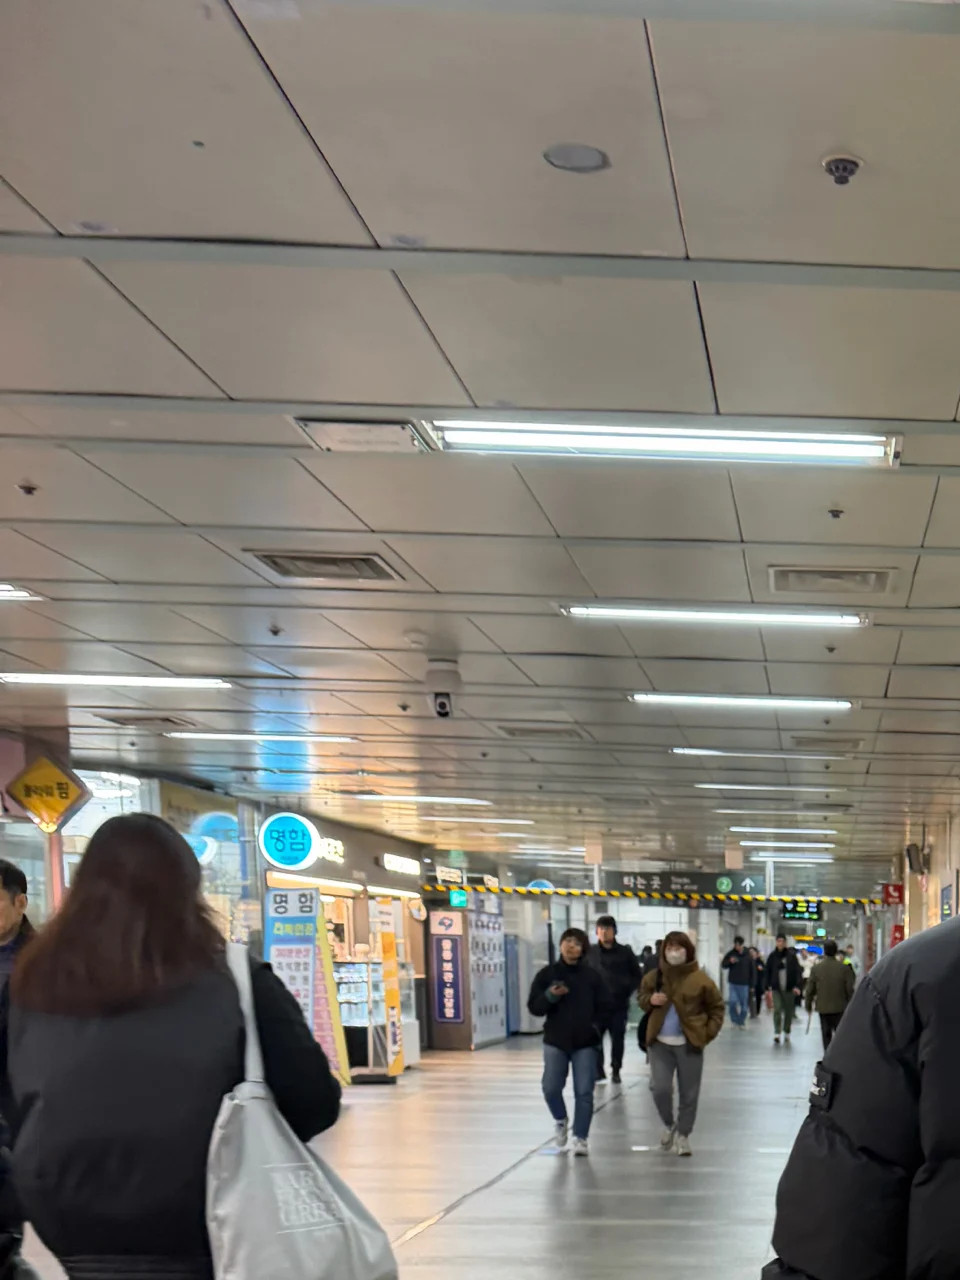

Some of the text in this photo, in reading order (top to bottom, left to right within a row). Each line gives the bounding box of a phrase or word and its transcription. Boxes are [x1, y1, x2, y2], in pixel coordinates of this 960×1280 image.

[269, 828, 306, 852] 명함
[623, 875, 647, 889] 타는
[651, 876, 662, 890] 곳
